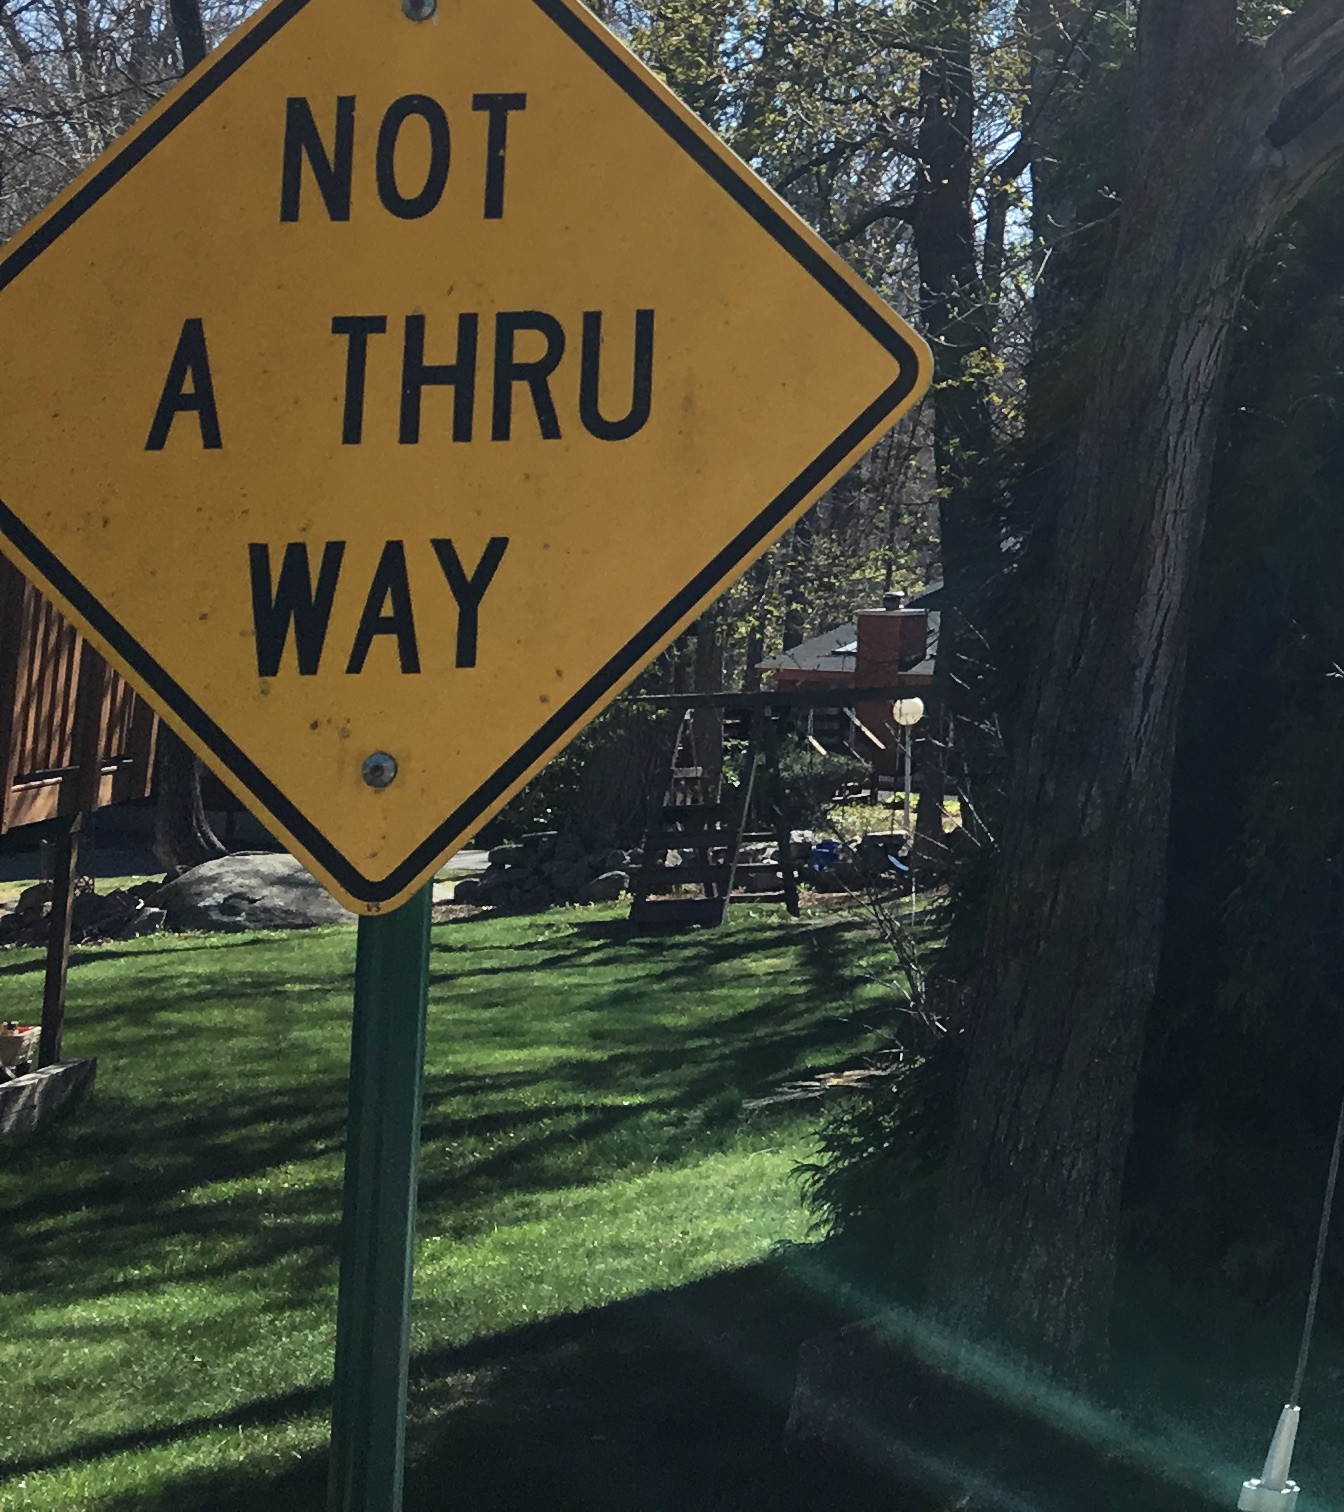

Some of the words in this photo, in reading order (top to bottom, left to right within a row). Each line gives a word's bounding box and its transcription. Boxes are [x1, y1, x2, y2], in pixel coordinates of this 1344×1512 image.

[280, 93, 526, 222] NOT
[144, 318, 222, 451] A
[332, 309, 654, 444] THRU
[248, 537, 509, 677] WAY
